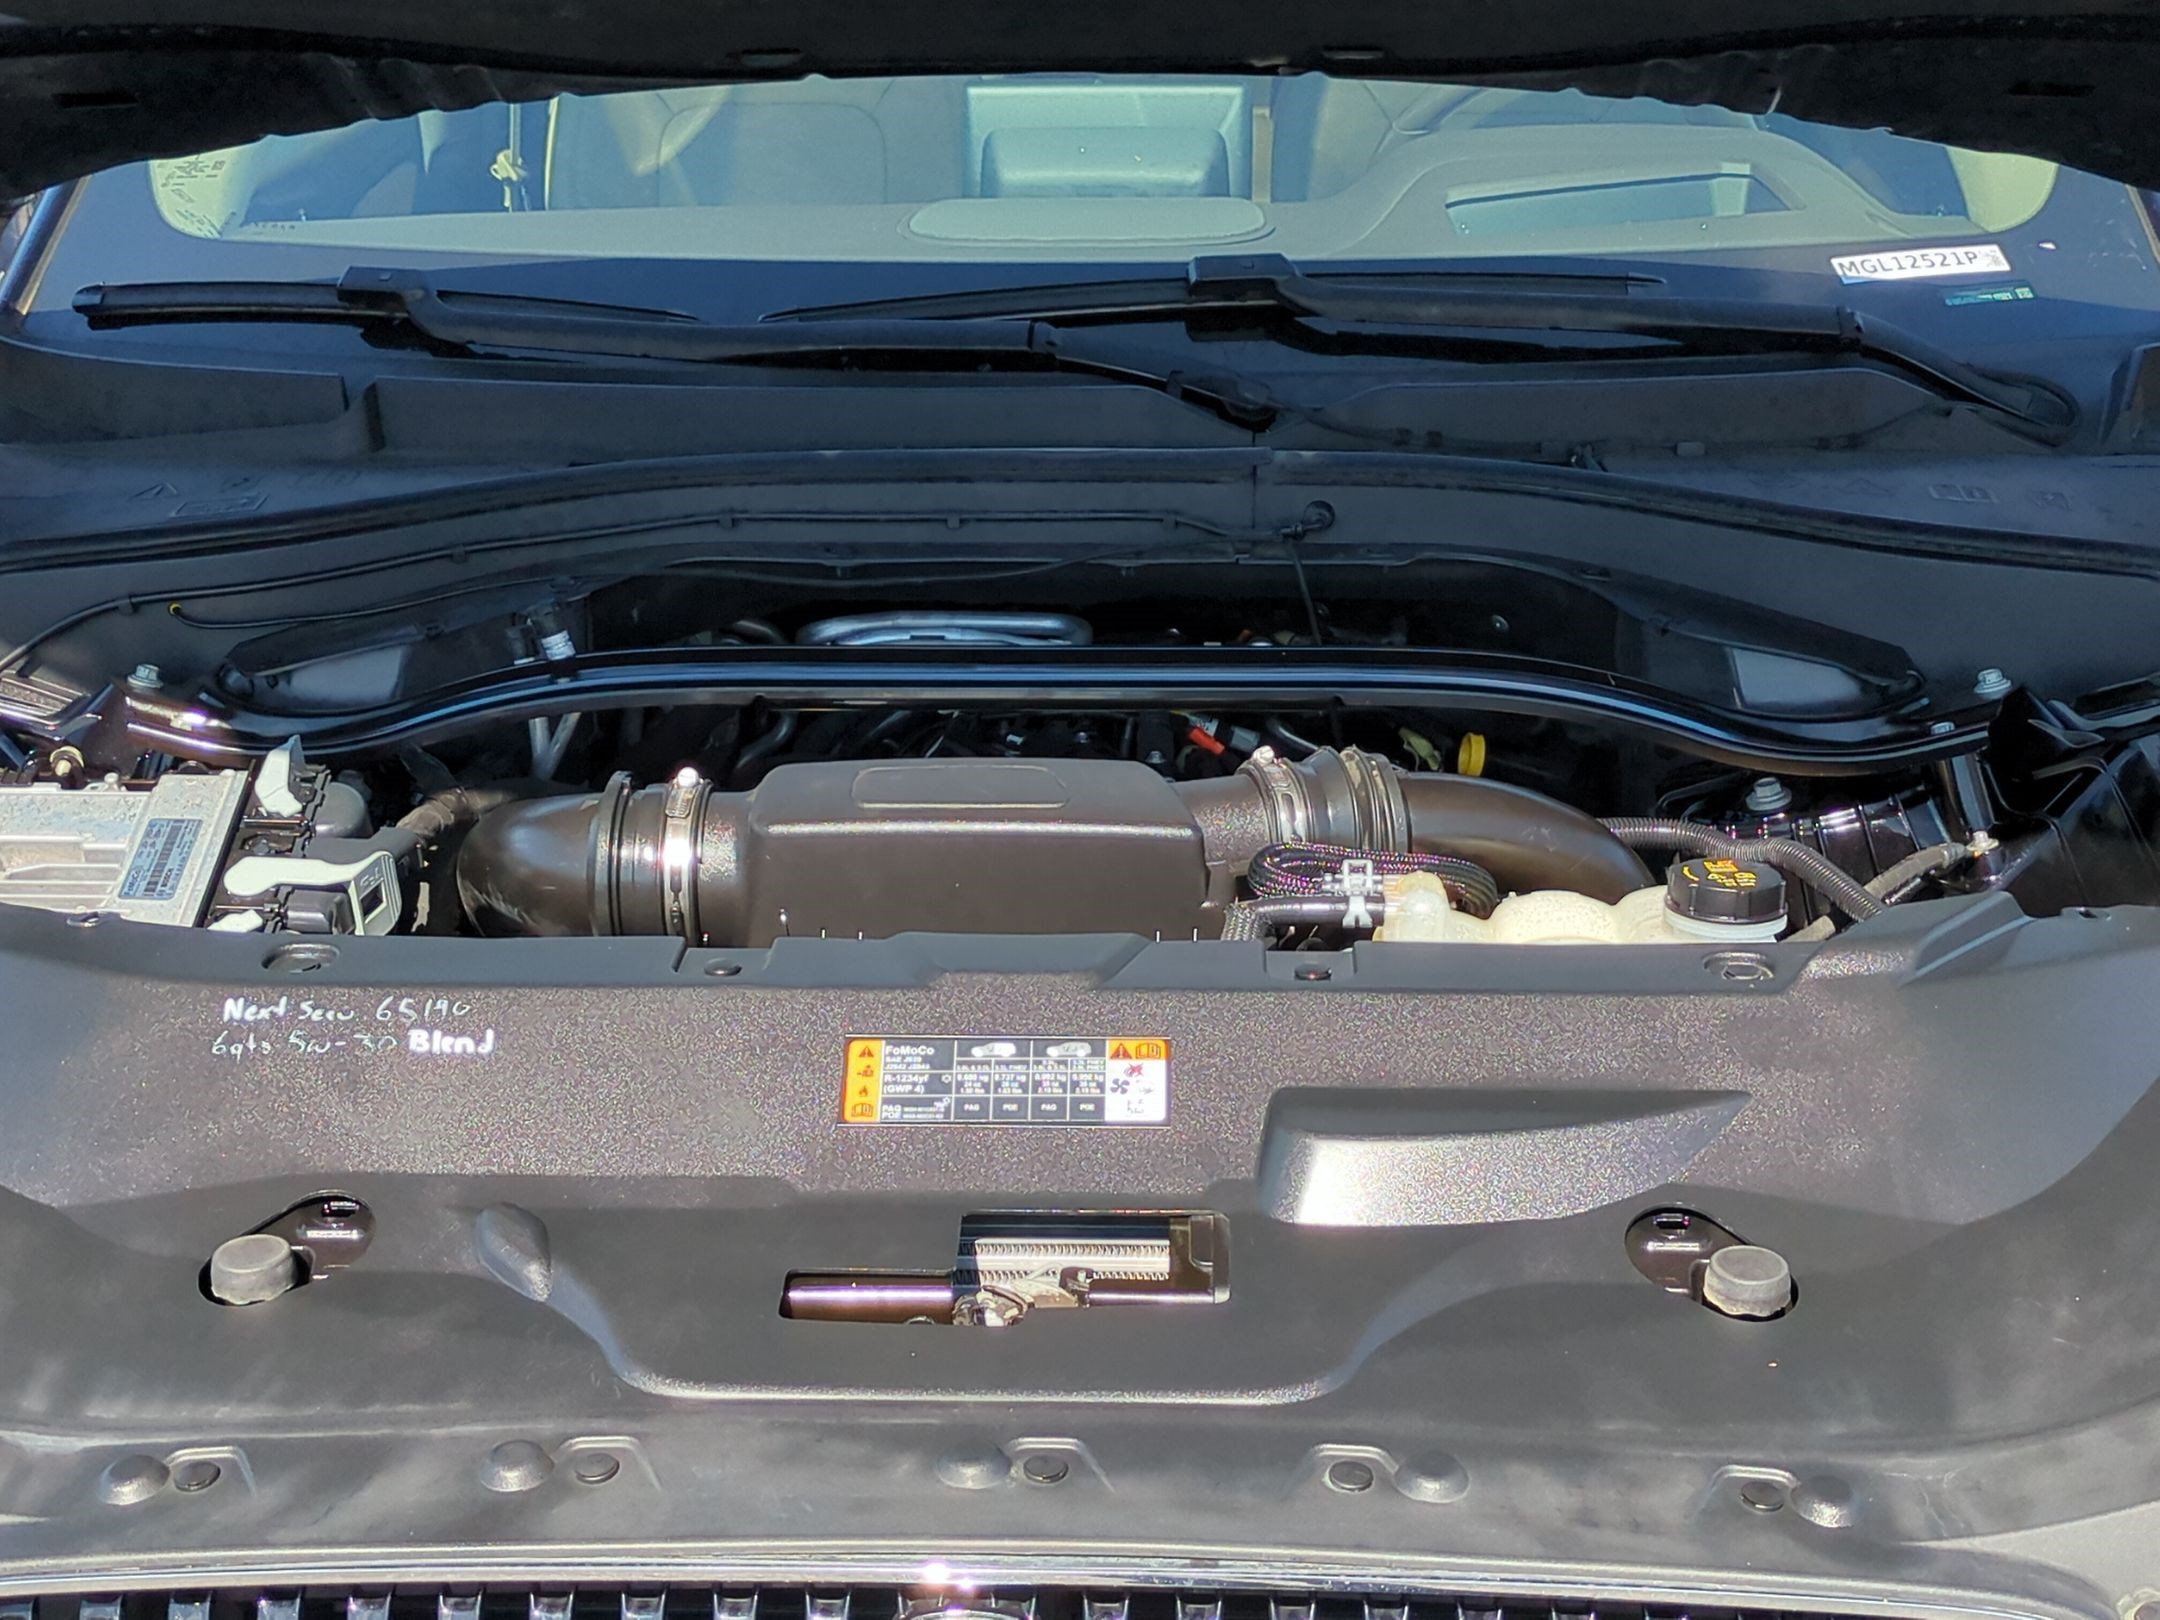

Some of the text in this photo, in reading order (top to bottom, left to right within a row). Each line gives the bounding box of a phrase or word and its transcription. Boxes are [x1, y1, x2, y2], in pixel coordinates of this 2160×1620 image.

[1838, 251, 1978, 275] MGL12521P
[407, 1028, 495, 1055] Blend
[885, 1045, 935, 1055] FoMoCo
[884, 1074, 930, 1084] R-1234yf
[883, 1084, 925, 1094] (GWP 4)
